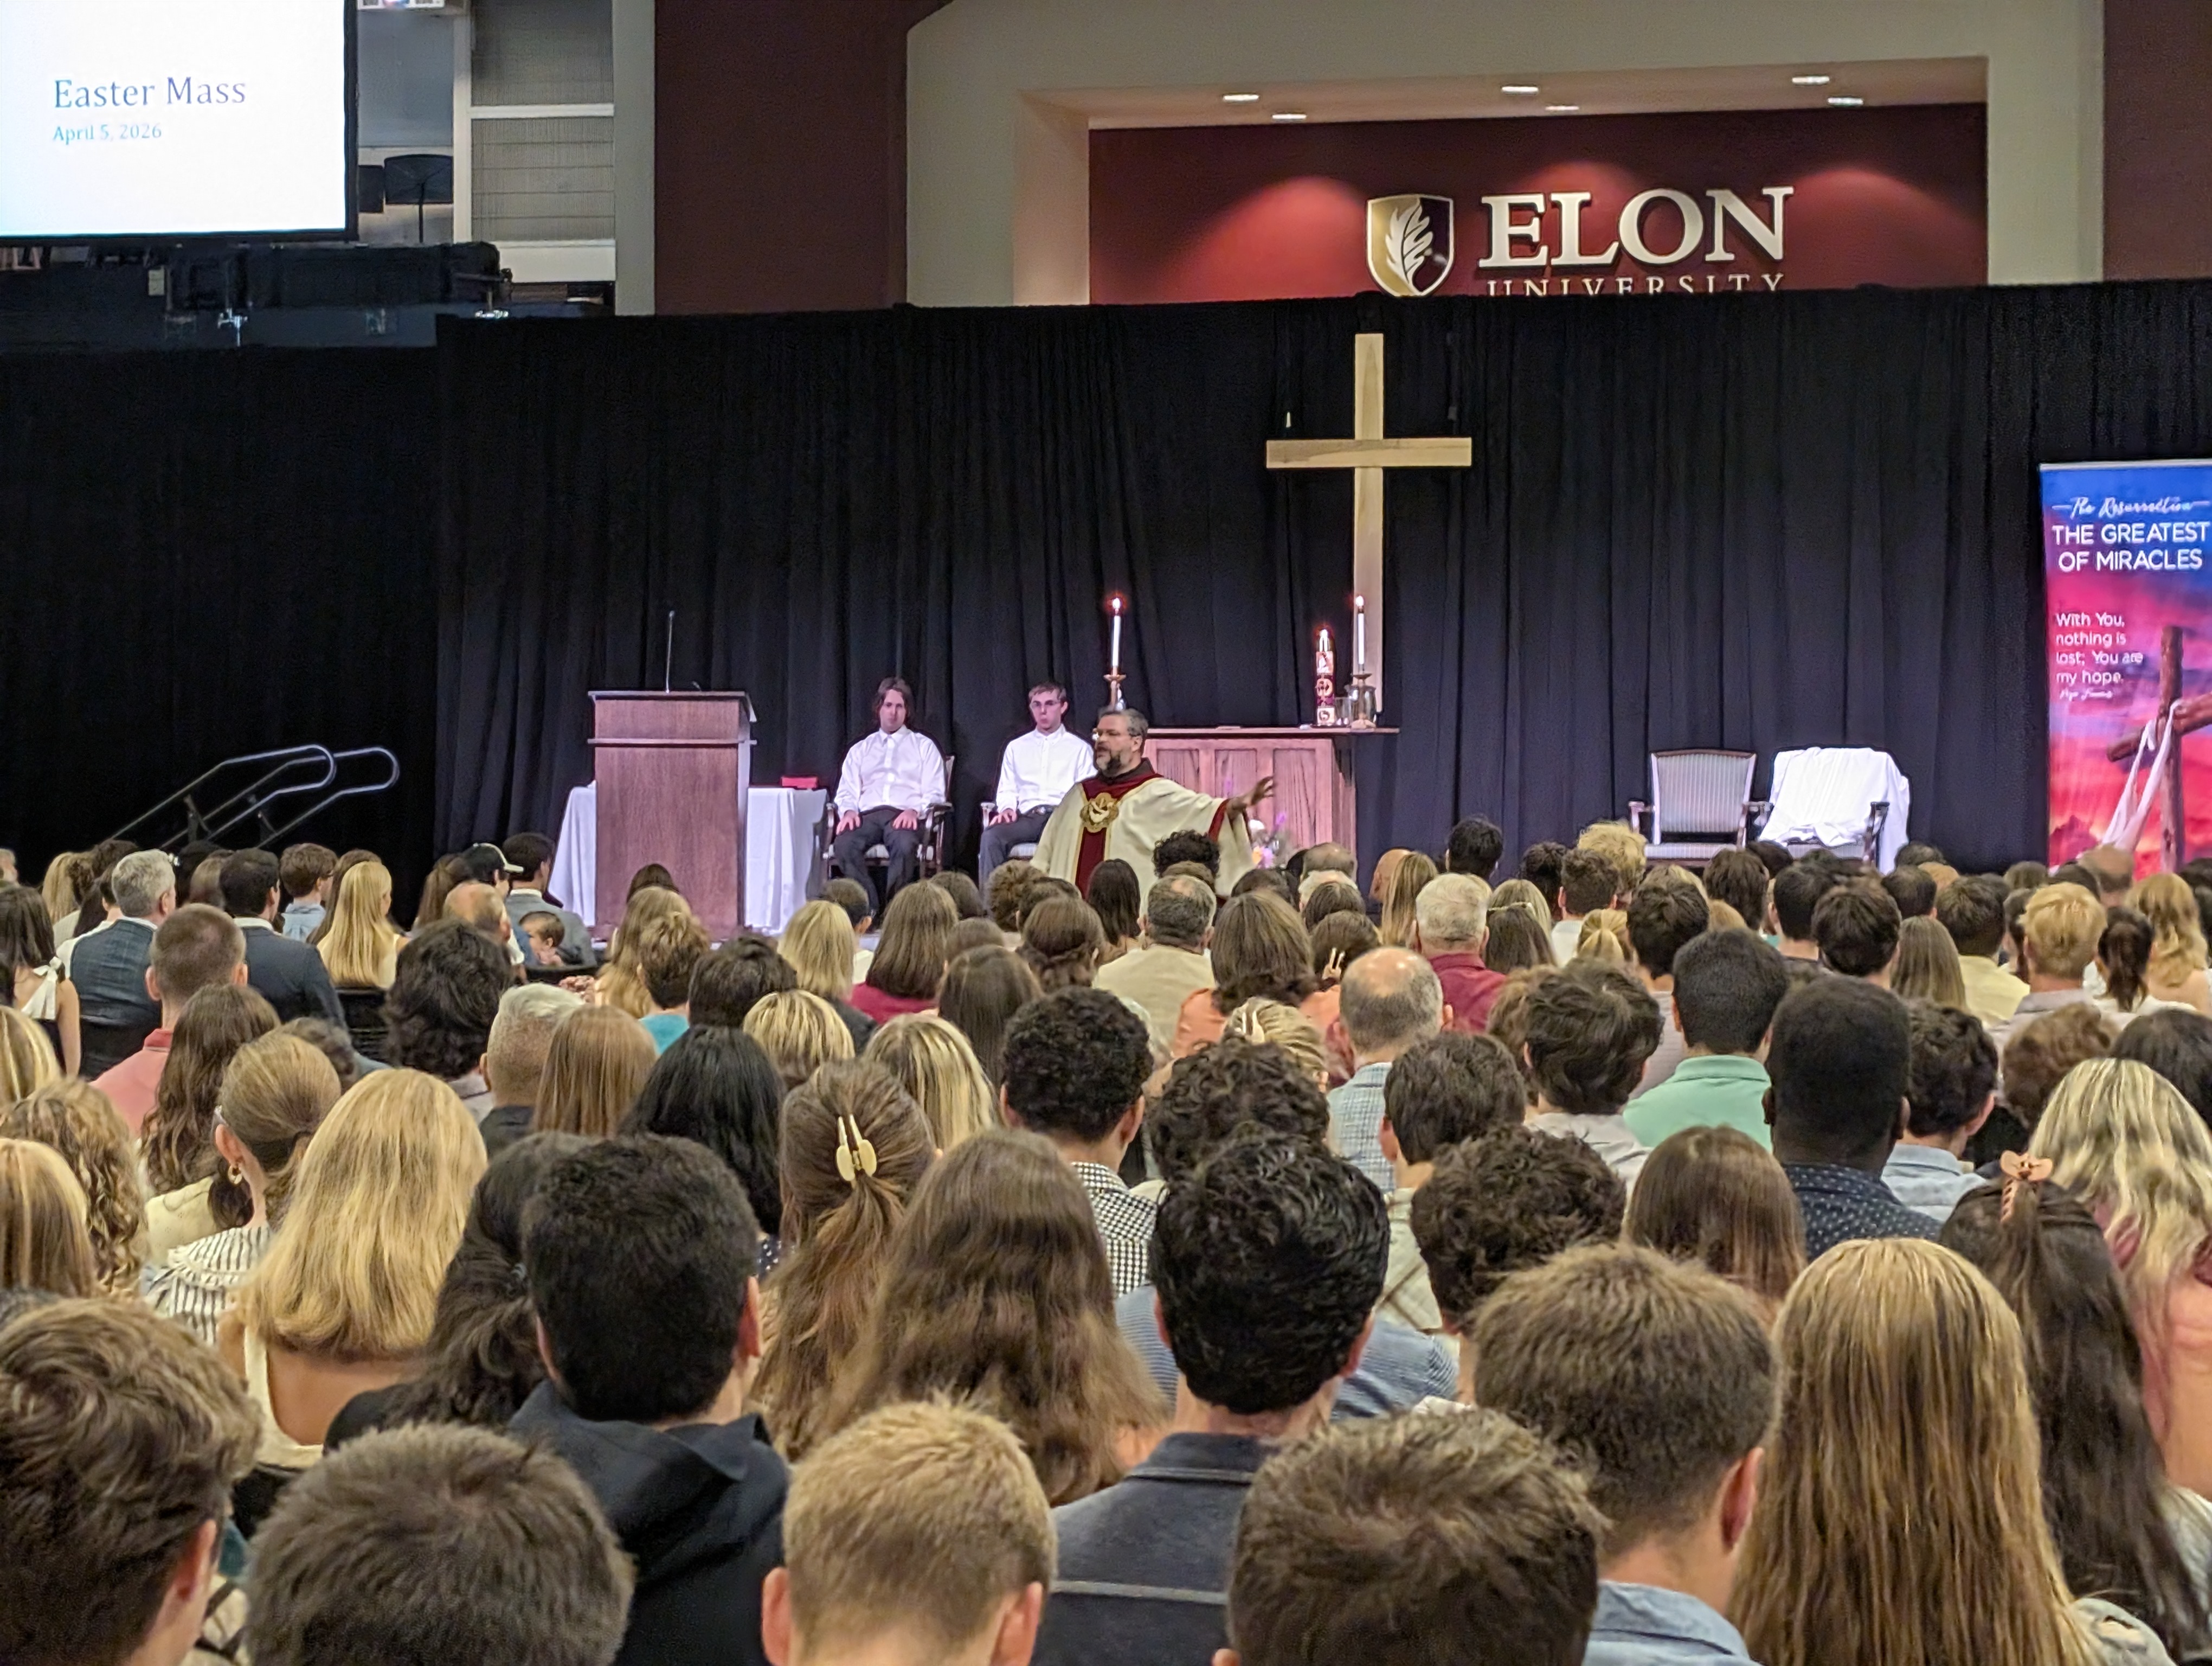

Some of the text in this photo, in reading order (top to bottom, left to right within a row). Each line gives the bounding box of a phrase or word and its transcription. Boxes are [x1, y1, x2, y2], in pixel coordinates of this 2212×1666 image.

[55, 76, 246, 108] Easter Mass
[53, 124, 94, 145] April
[120, 123, 162, 139] 2026
[1479, 187, 1794, 267] ELON
[2052, 521, 2210, 544] THE GREATEST
[2059, 548, 2203, 572] OF MIRACLES
[2056, 612, 2125, 627] With You,
[2056, 631, 2126, 648] nothing is
[2091, 650, 2119, 665] You
[2121, 652, 2144, 664] are
[2056, 671, 2078, 687] my
